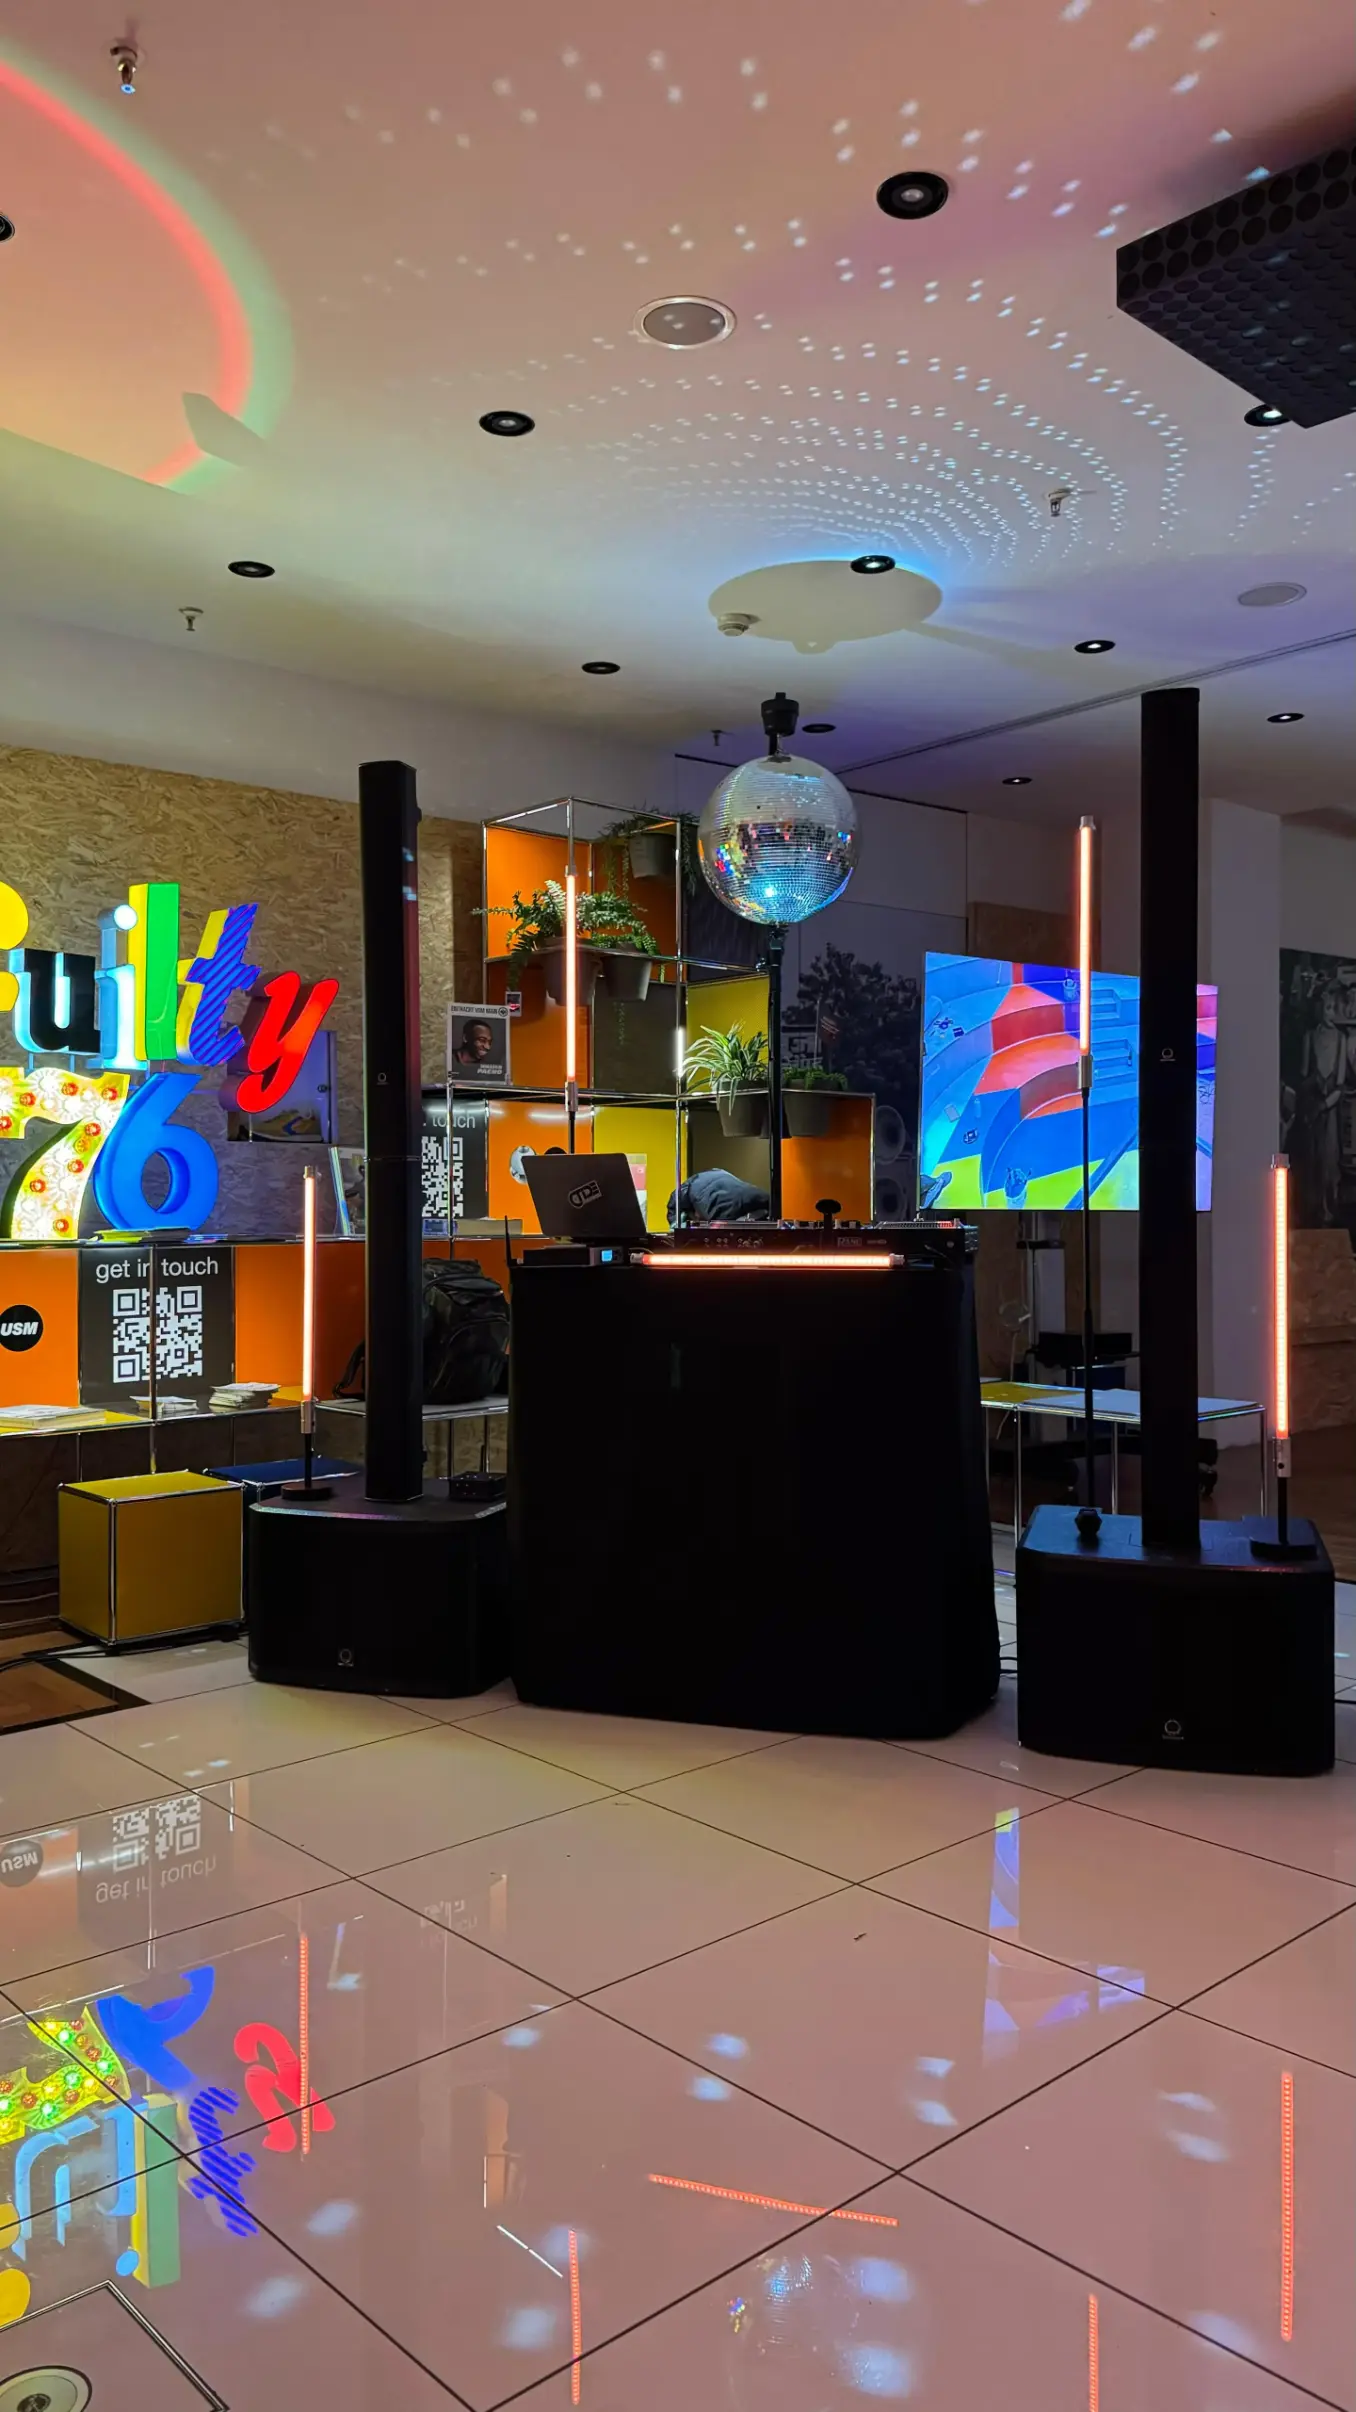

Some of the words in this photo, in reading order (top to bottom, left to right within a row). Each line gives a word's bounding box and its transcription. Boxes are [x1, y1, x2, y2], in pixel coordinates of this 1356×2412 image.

[0, 881, 340, 1114] uilty
[96, 1259, 131, 1284] get
[161, 1256, 219, 1277] touch
[0, 1321, 39, 1337] USM
